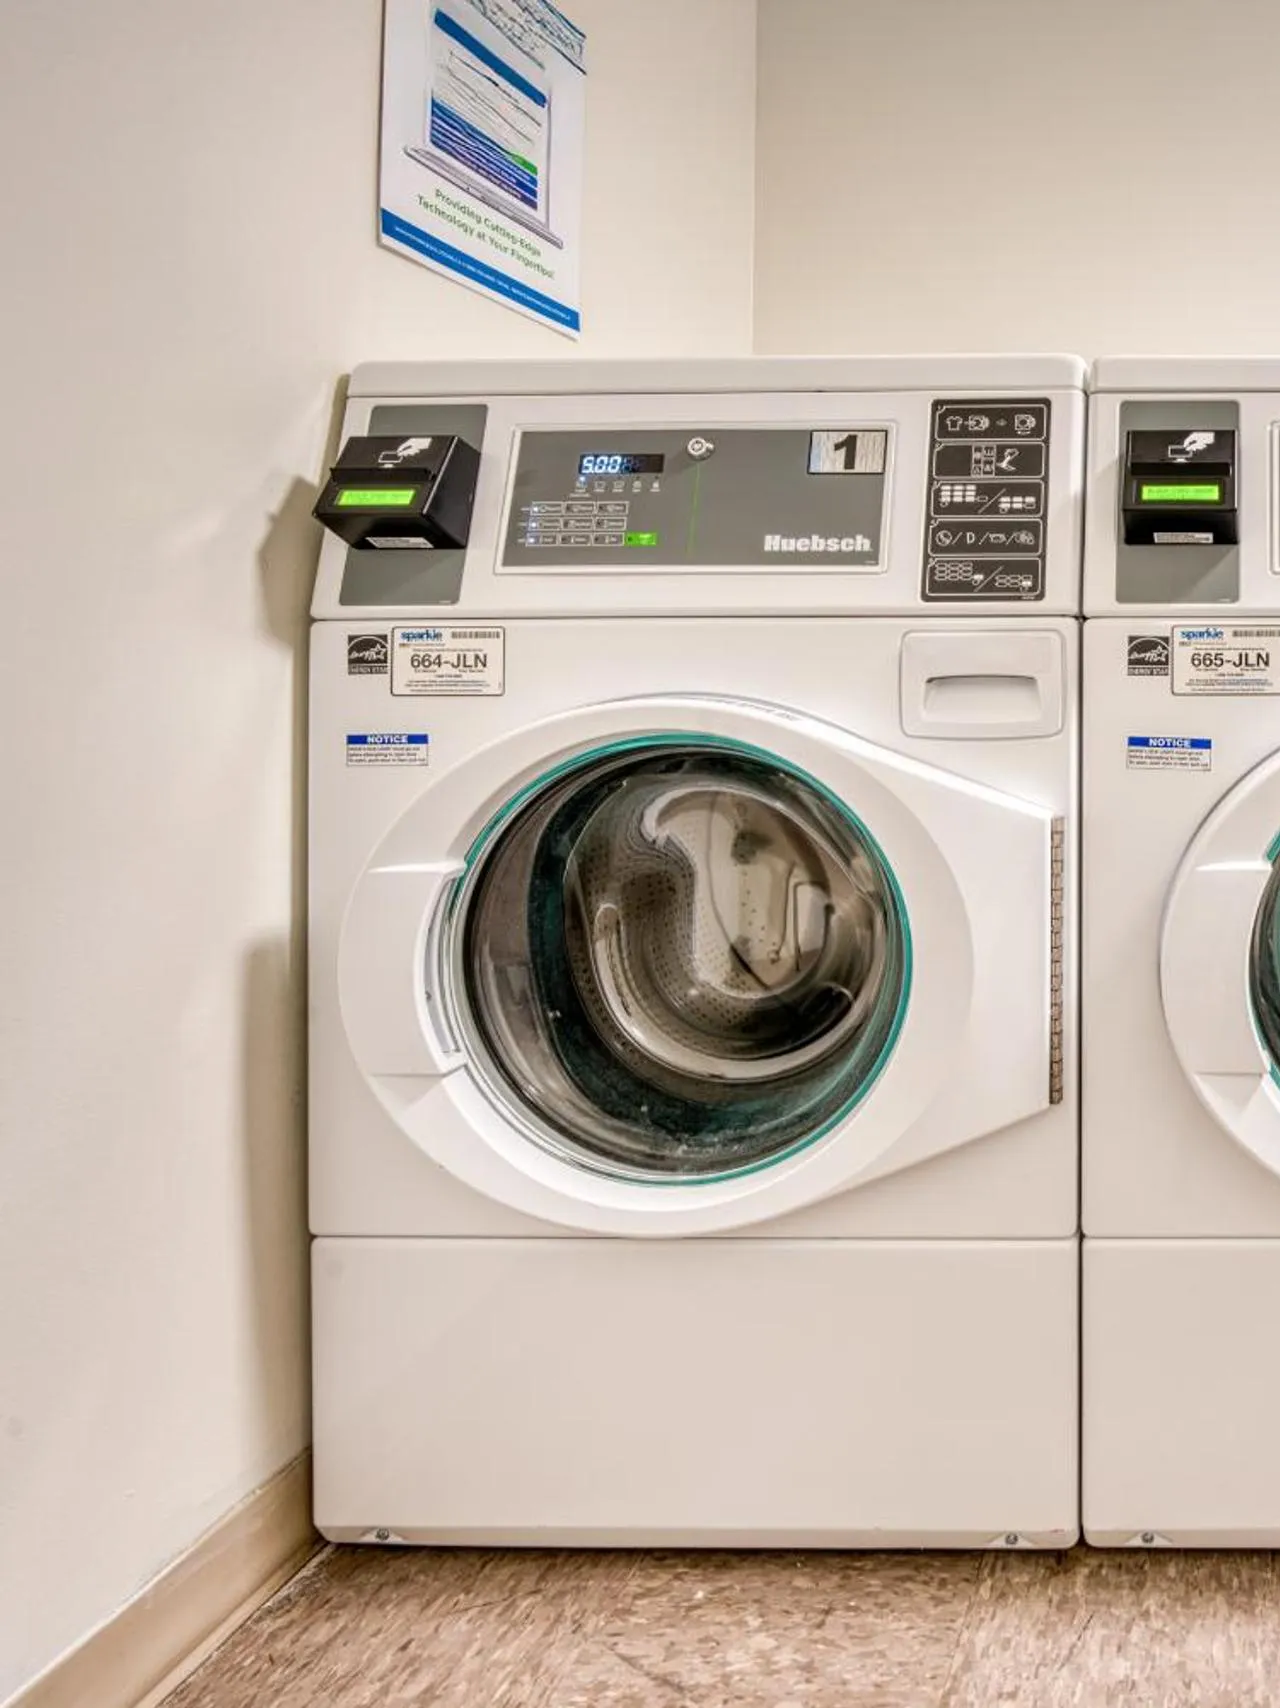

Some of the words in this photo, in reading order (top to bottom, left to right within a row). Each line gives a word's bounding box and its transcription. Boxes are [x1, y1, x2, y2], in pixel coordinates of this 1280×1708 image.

[435, 188, 482, 225] Providing
[415, 193, 474, 237] Technology
[489, 236, 510, 254] Your
[833, 434, 858, 470] 1
[764, 534, 872, 552] Huebsch
[410, 653, 488, 669] 664-JLN
[1191, 652, 1270, 668] 665-JLN
[366, 735, 409, 744] NOTICE
[1149, 738, 1191, 748] NOTICE
